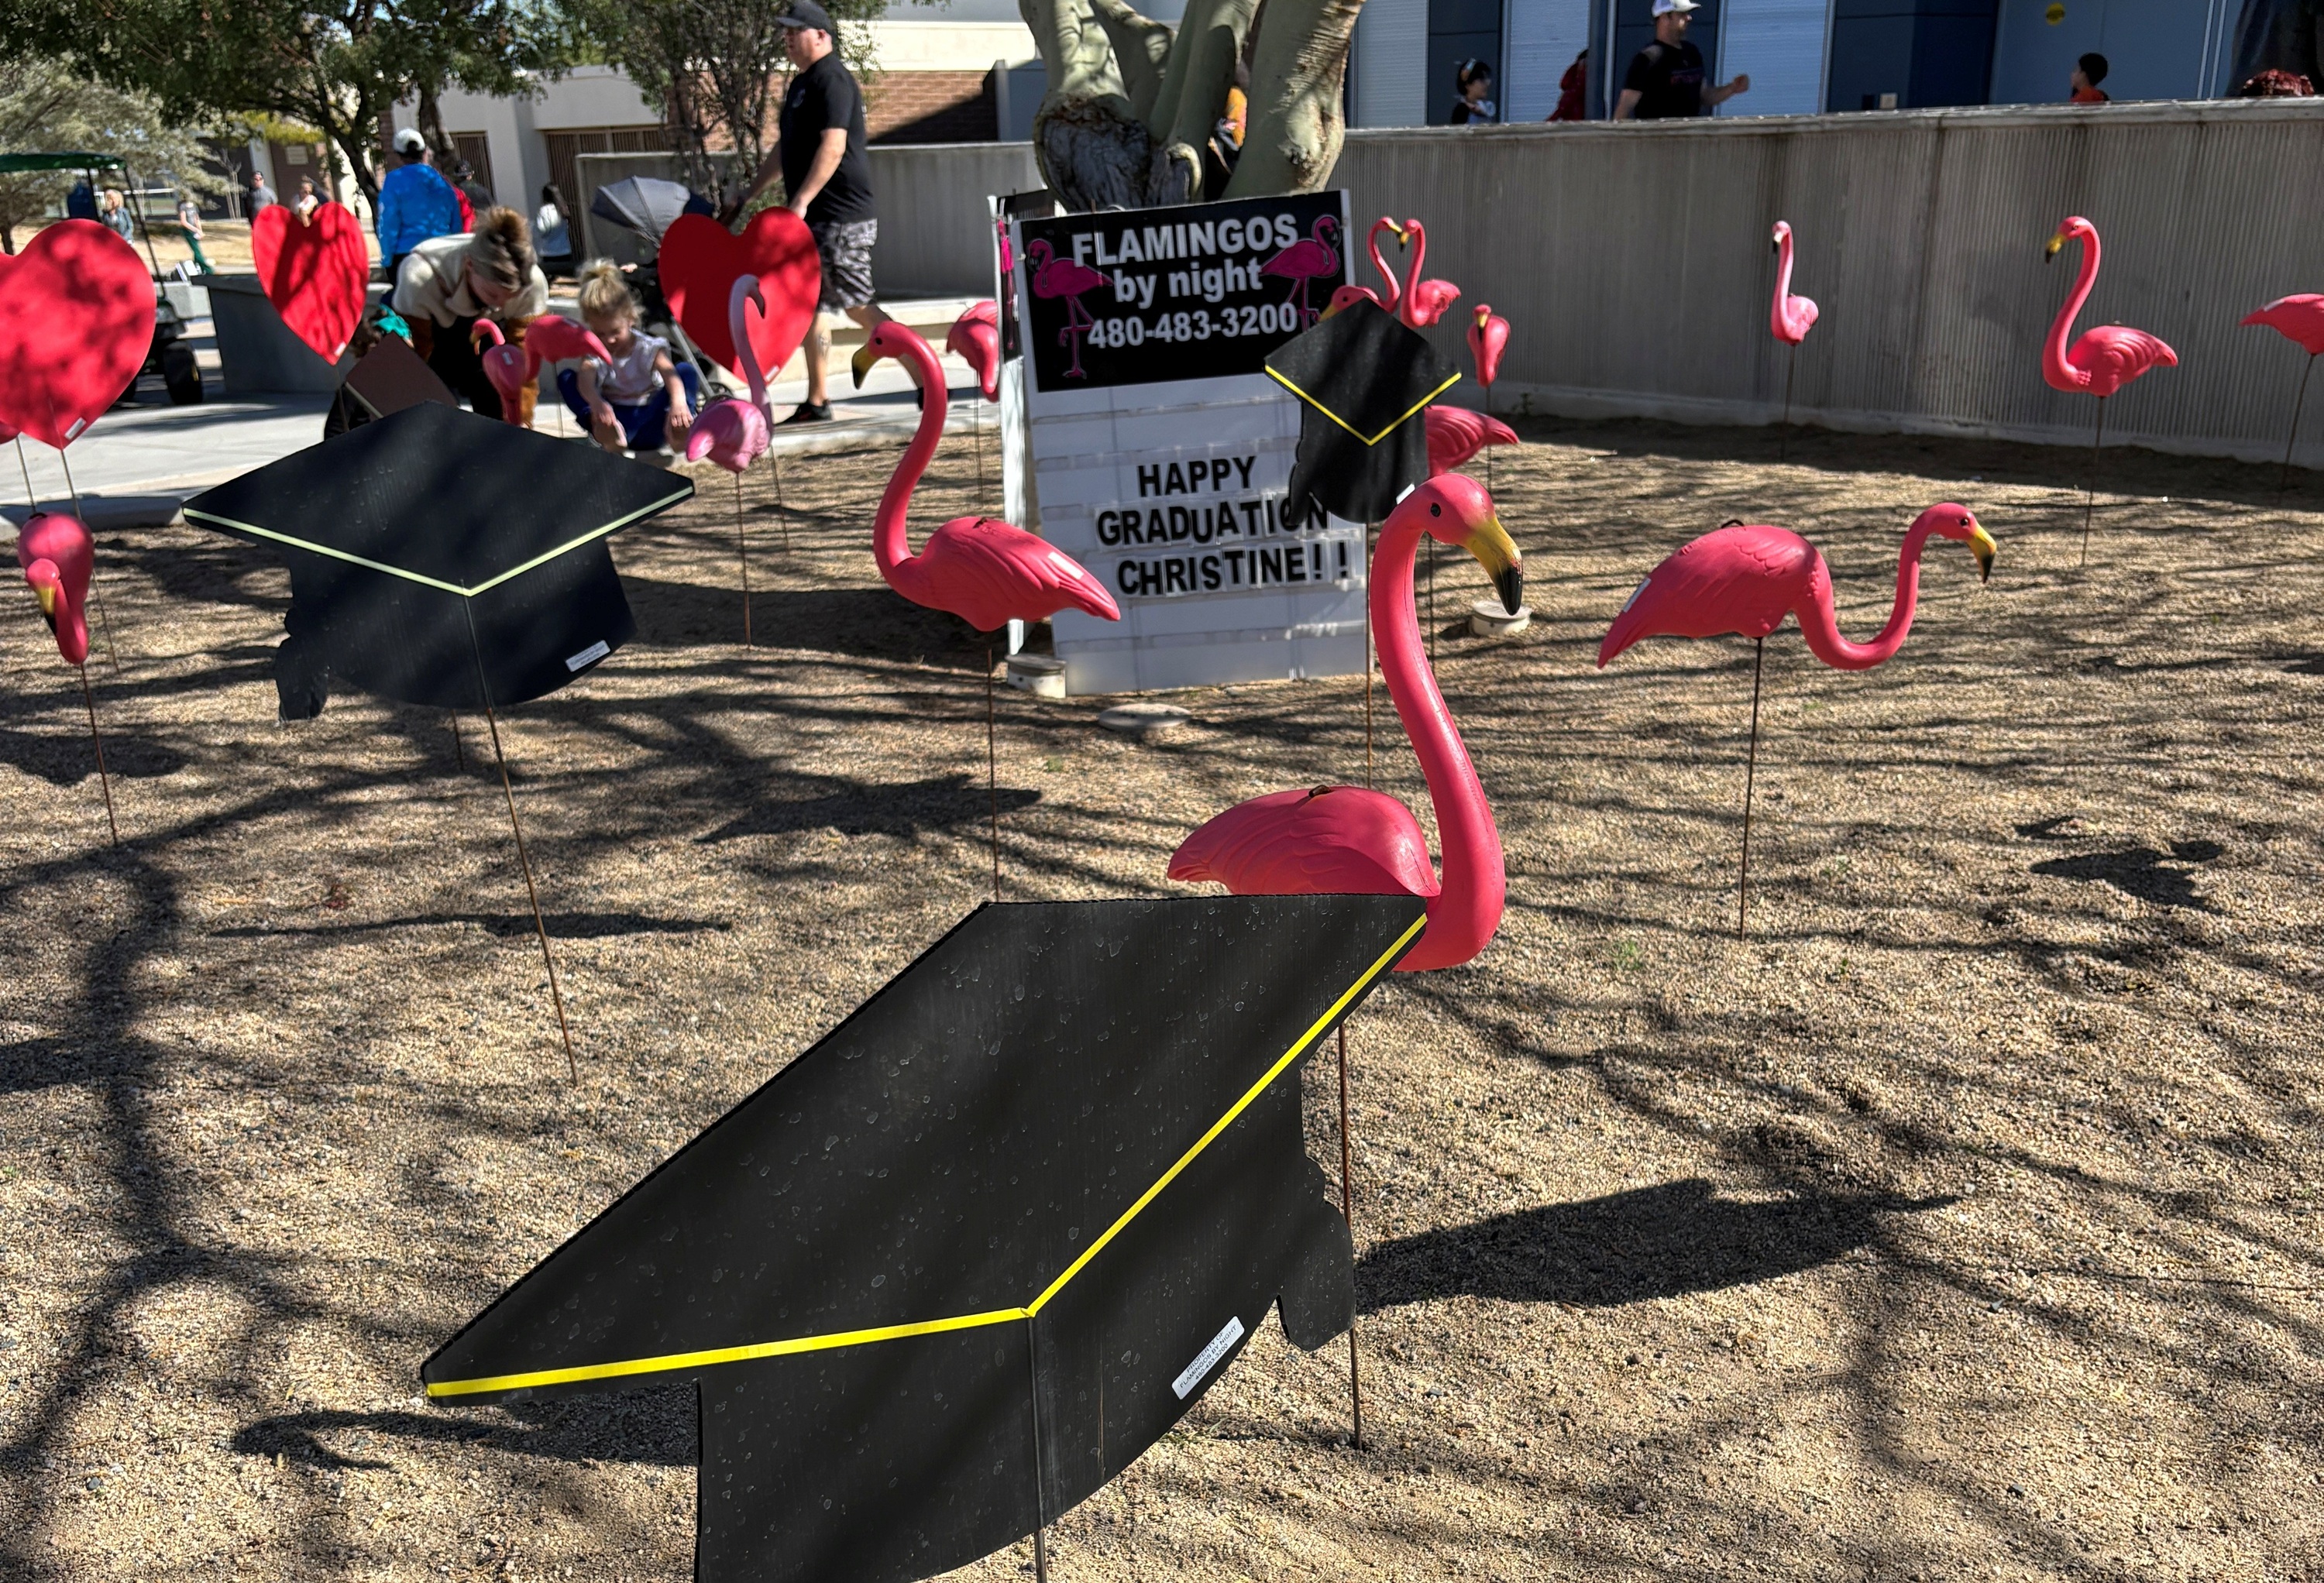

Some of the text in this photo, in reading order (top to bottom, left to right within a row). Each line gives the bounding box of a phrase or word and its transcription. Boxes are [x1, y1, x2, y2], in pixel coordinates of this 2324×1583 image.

[1072, 214, 1298, 267] FLAMINGOS
[1113, 256, 1263, 309] by night
[1087, 303, 1298, 349] 480-483-3200
[1137, 456, 1257, 497] HAPPY
